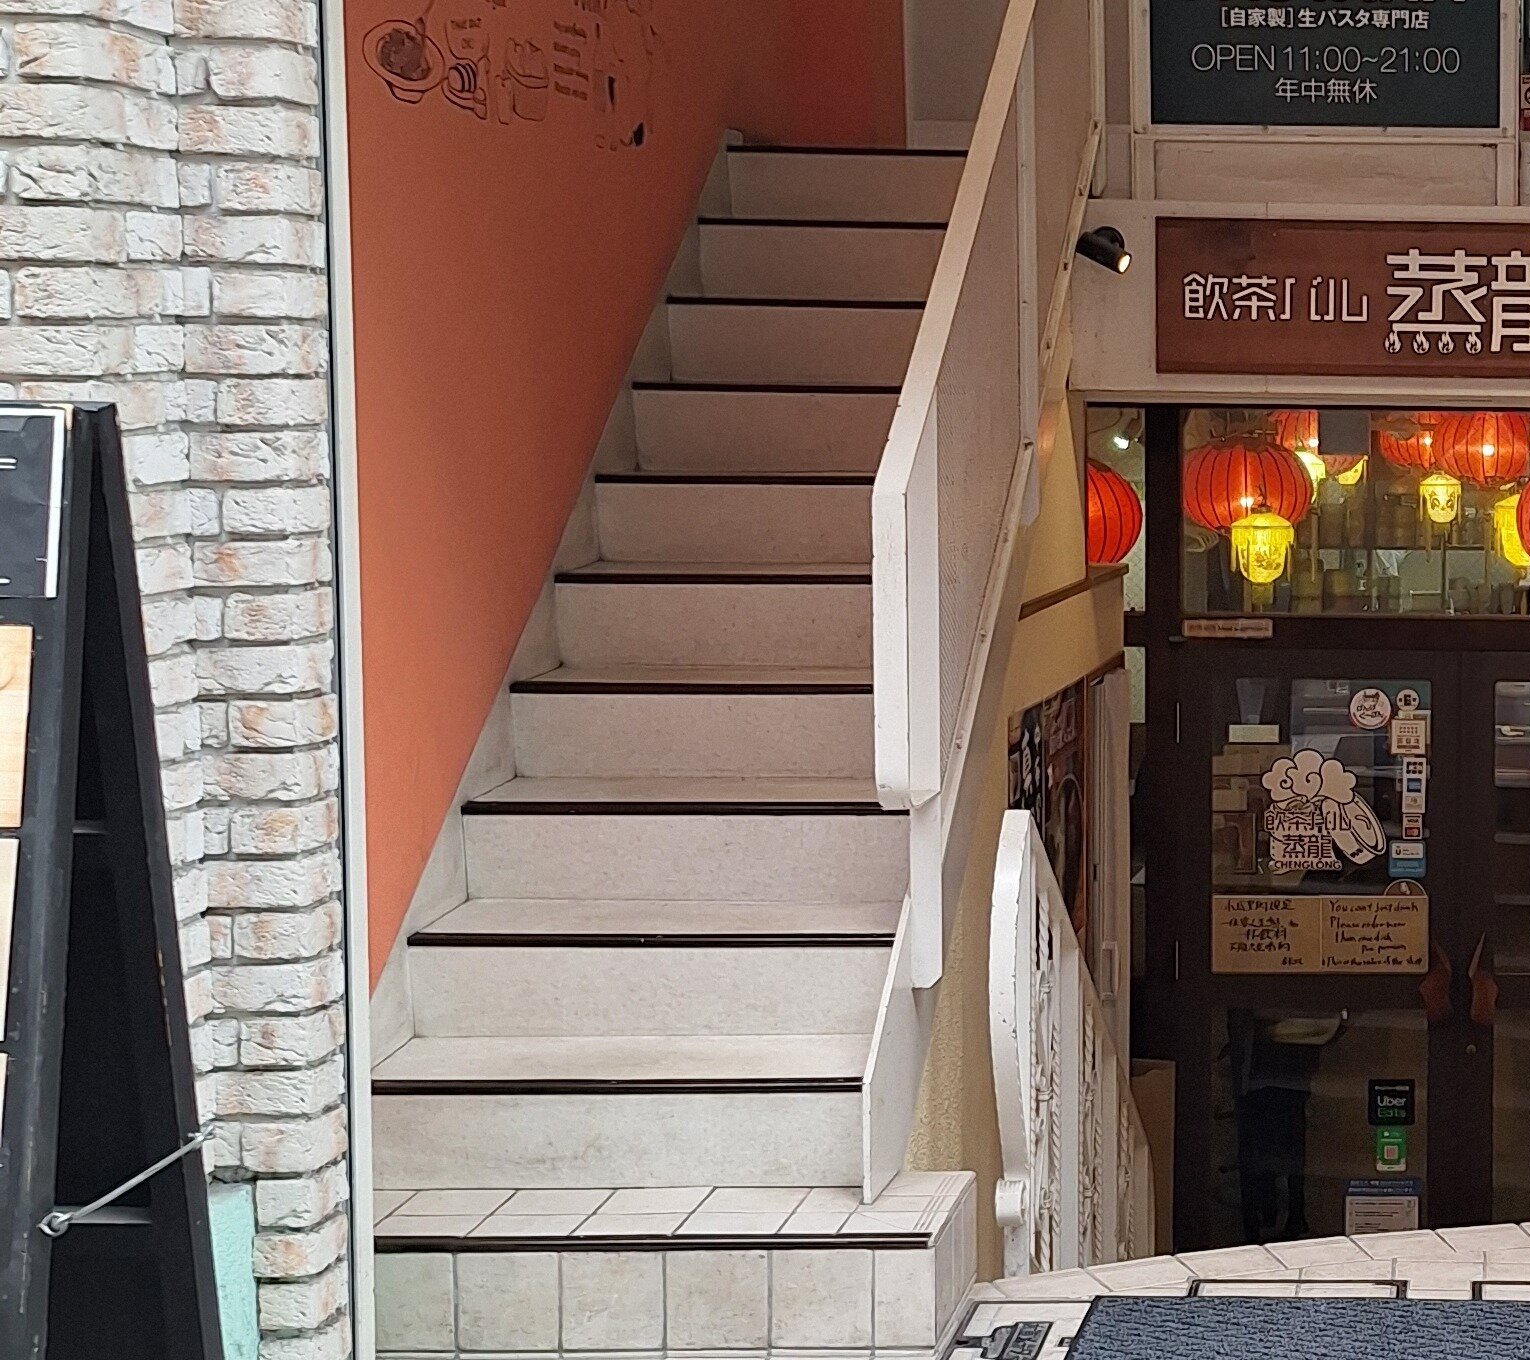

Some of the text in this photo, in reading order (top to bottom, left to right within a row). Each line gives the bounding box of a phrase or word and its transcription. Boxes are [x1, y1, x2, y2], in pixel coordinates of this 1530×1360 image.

[1191, 43, 1275, 71] OPEN
[1274, 77, 1378, 104] 年中無休
[1182, 272, 1369, 323] 飲茶バル
[1274, 860, 1342, 871] CHENGLONG
[1329, 900, 1348, 913] You
[1377, 1095, 1406, 1107] Uber
